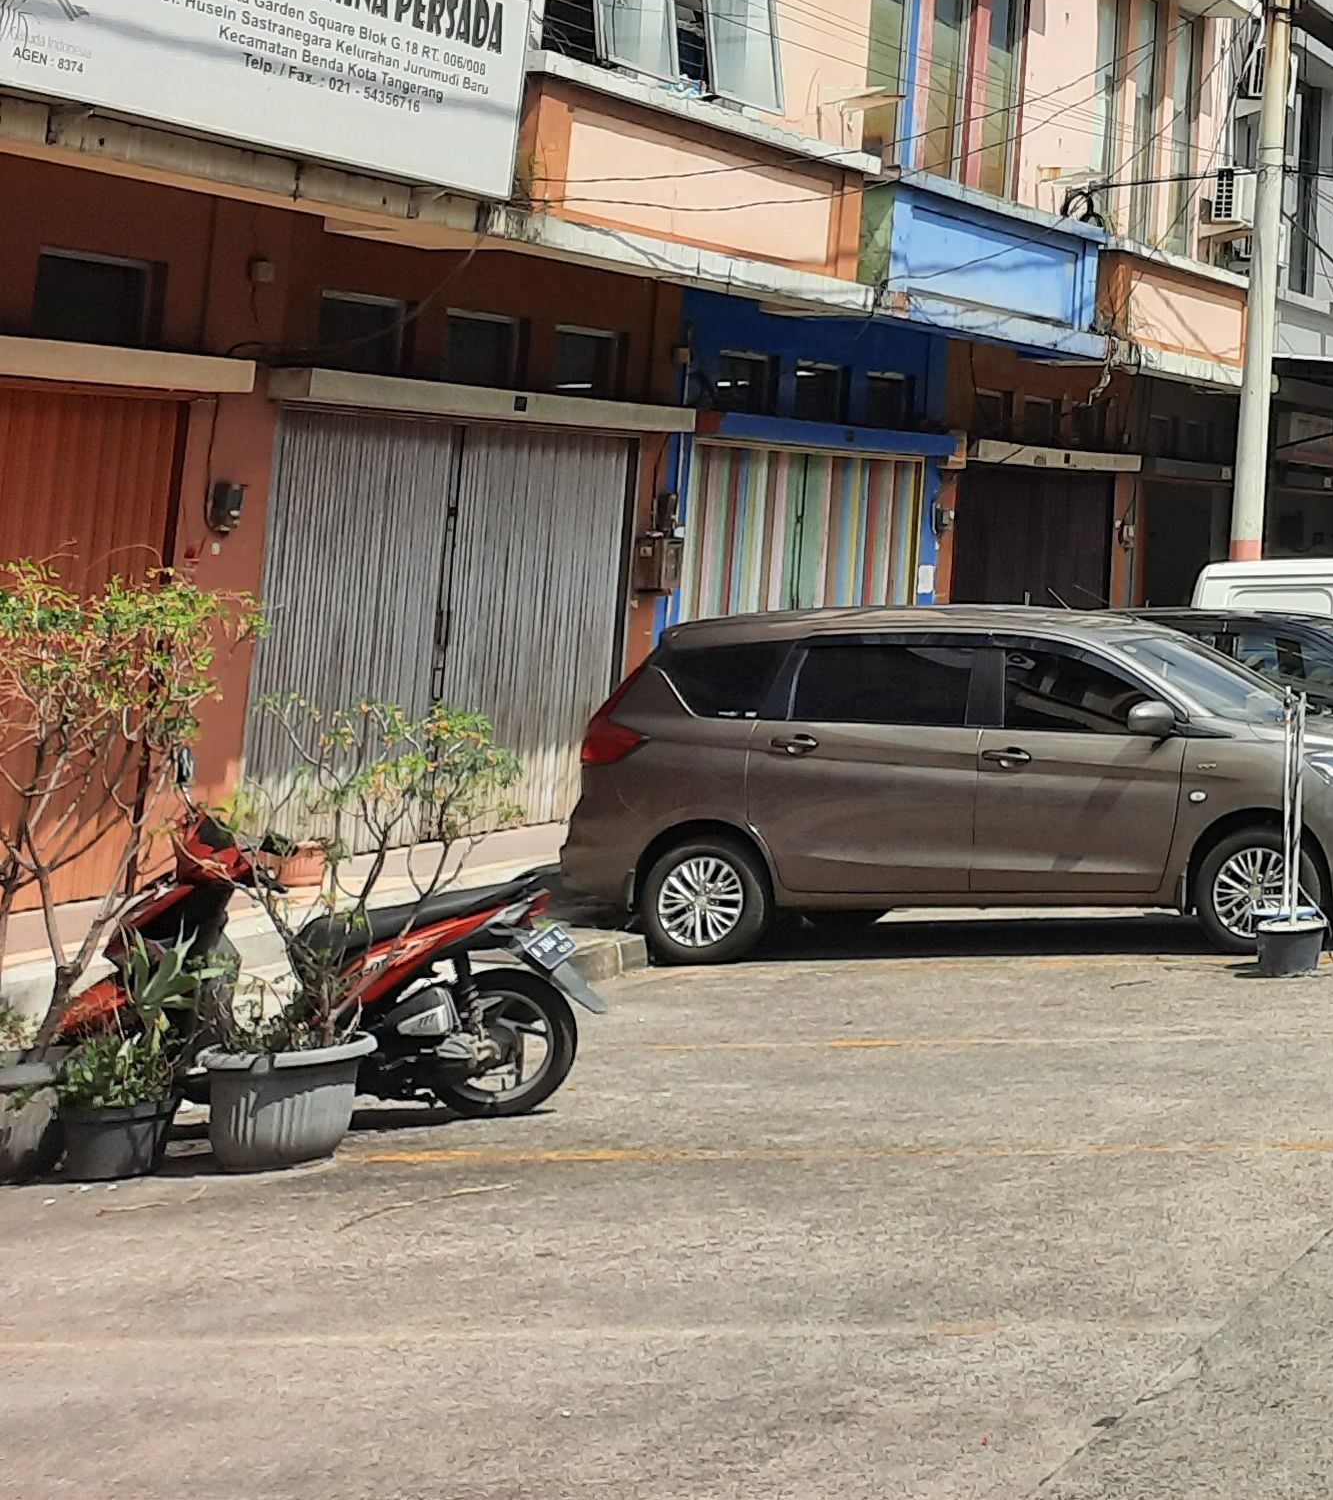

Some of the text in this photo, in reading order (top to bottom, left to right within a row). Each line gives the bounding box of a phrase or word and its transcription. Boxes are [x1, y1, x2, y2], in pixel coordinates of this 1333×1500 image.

[12, 47, 48, 66] AGEN
[57, 58, 84, 73] 8374
[219, 25, 444, 103] Kecamatan Benda Kota Tangerang
[240, 11, 332, 49] Sastranegara
[336, 39, 400, 69] Kelurahan
[403, 59, 459, 86] Jurumudi
[462, 76, 489, 95] Baru
[308, 10, 355, 36] Square
[359, 26, 387, 46] Blok
[391, 37, 418, 55] G.18
[421, 45, 439, 62] RT.
[243, 52, 276, 75] Telp.
[328, 77, 350, 95] 021
[363, 86, 420, 113] 54356716
